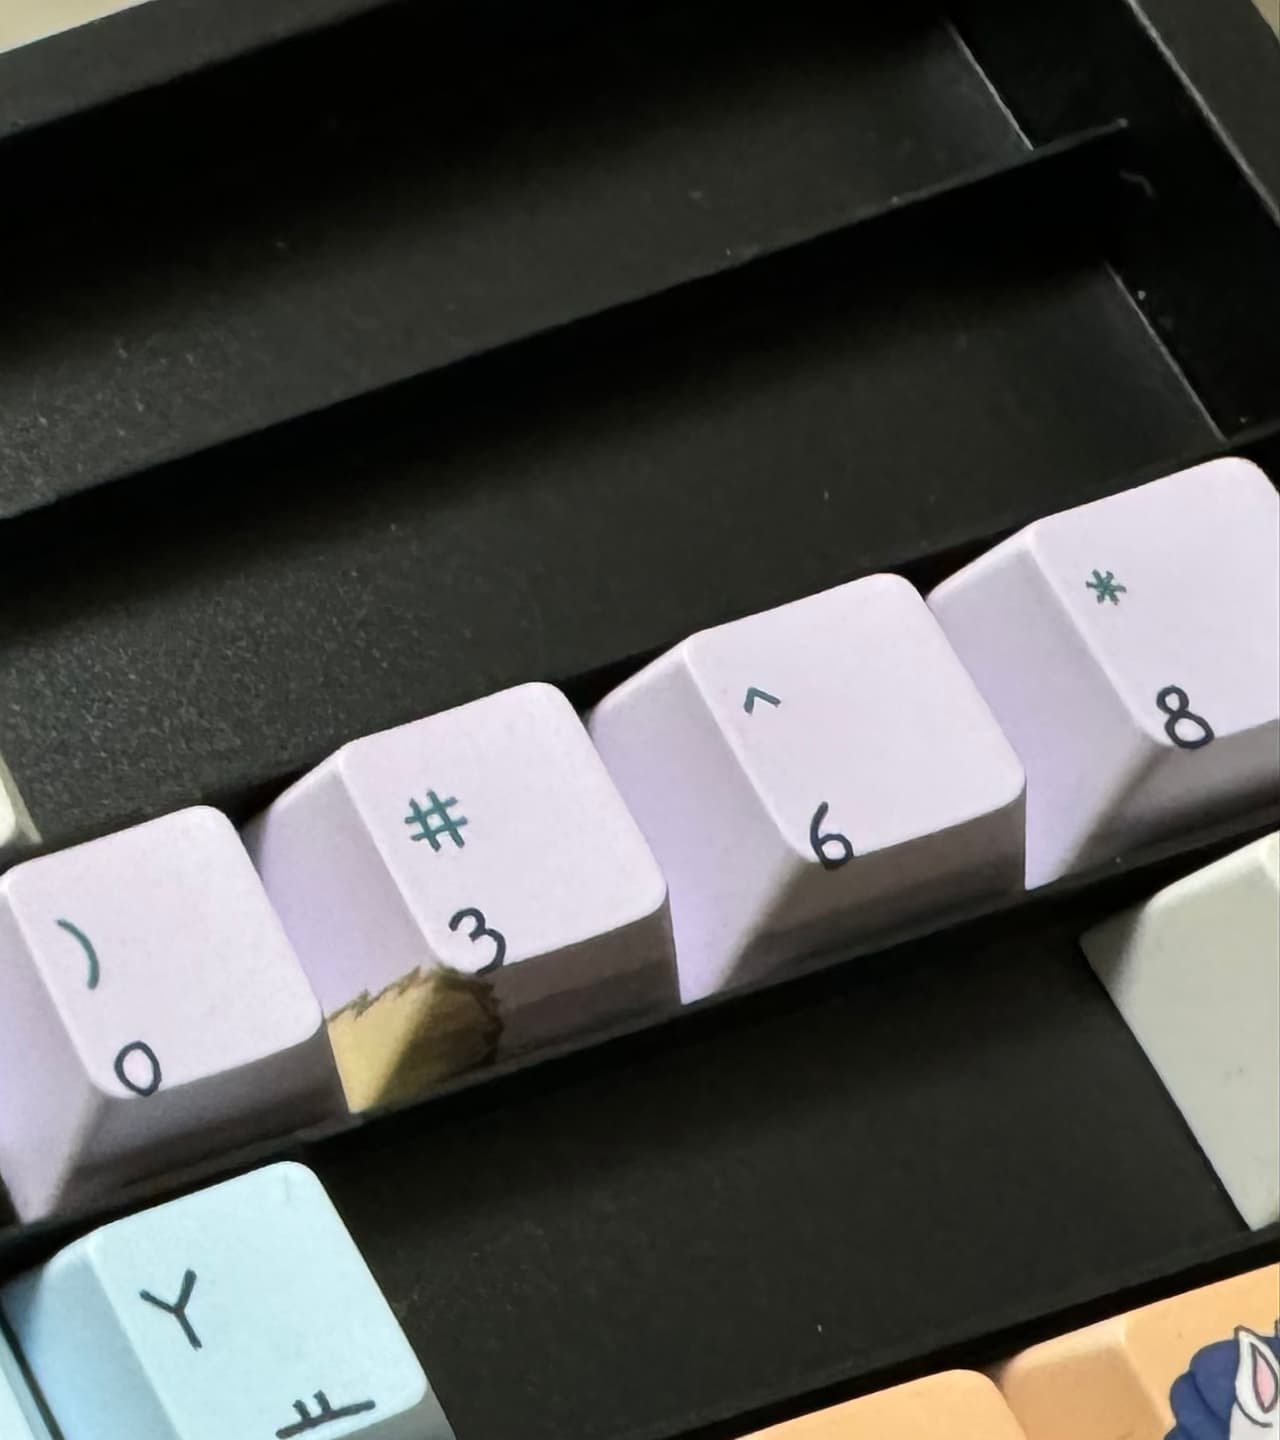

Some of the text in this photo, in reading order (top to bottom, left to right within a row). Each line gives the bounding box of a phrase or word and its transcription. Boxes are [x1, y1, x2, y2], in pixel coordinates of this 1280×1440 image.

[1156, 685, 1213, 750] 8
[404, 790, 468, 853] #
[809, 801, 853, 869] 6
[56, 919, 101, 990] )
[449, 907, 505, 975] 3
[138, 1268, 203, 1351] Y
